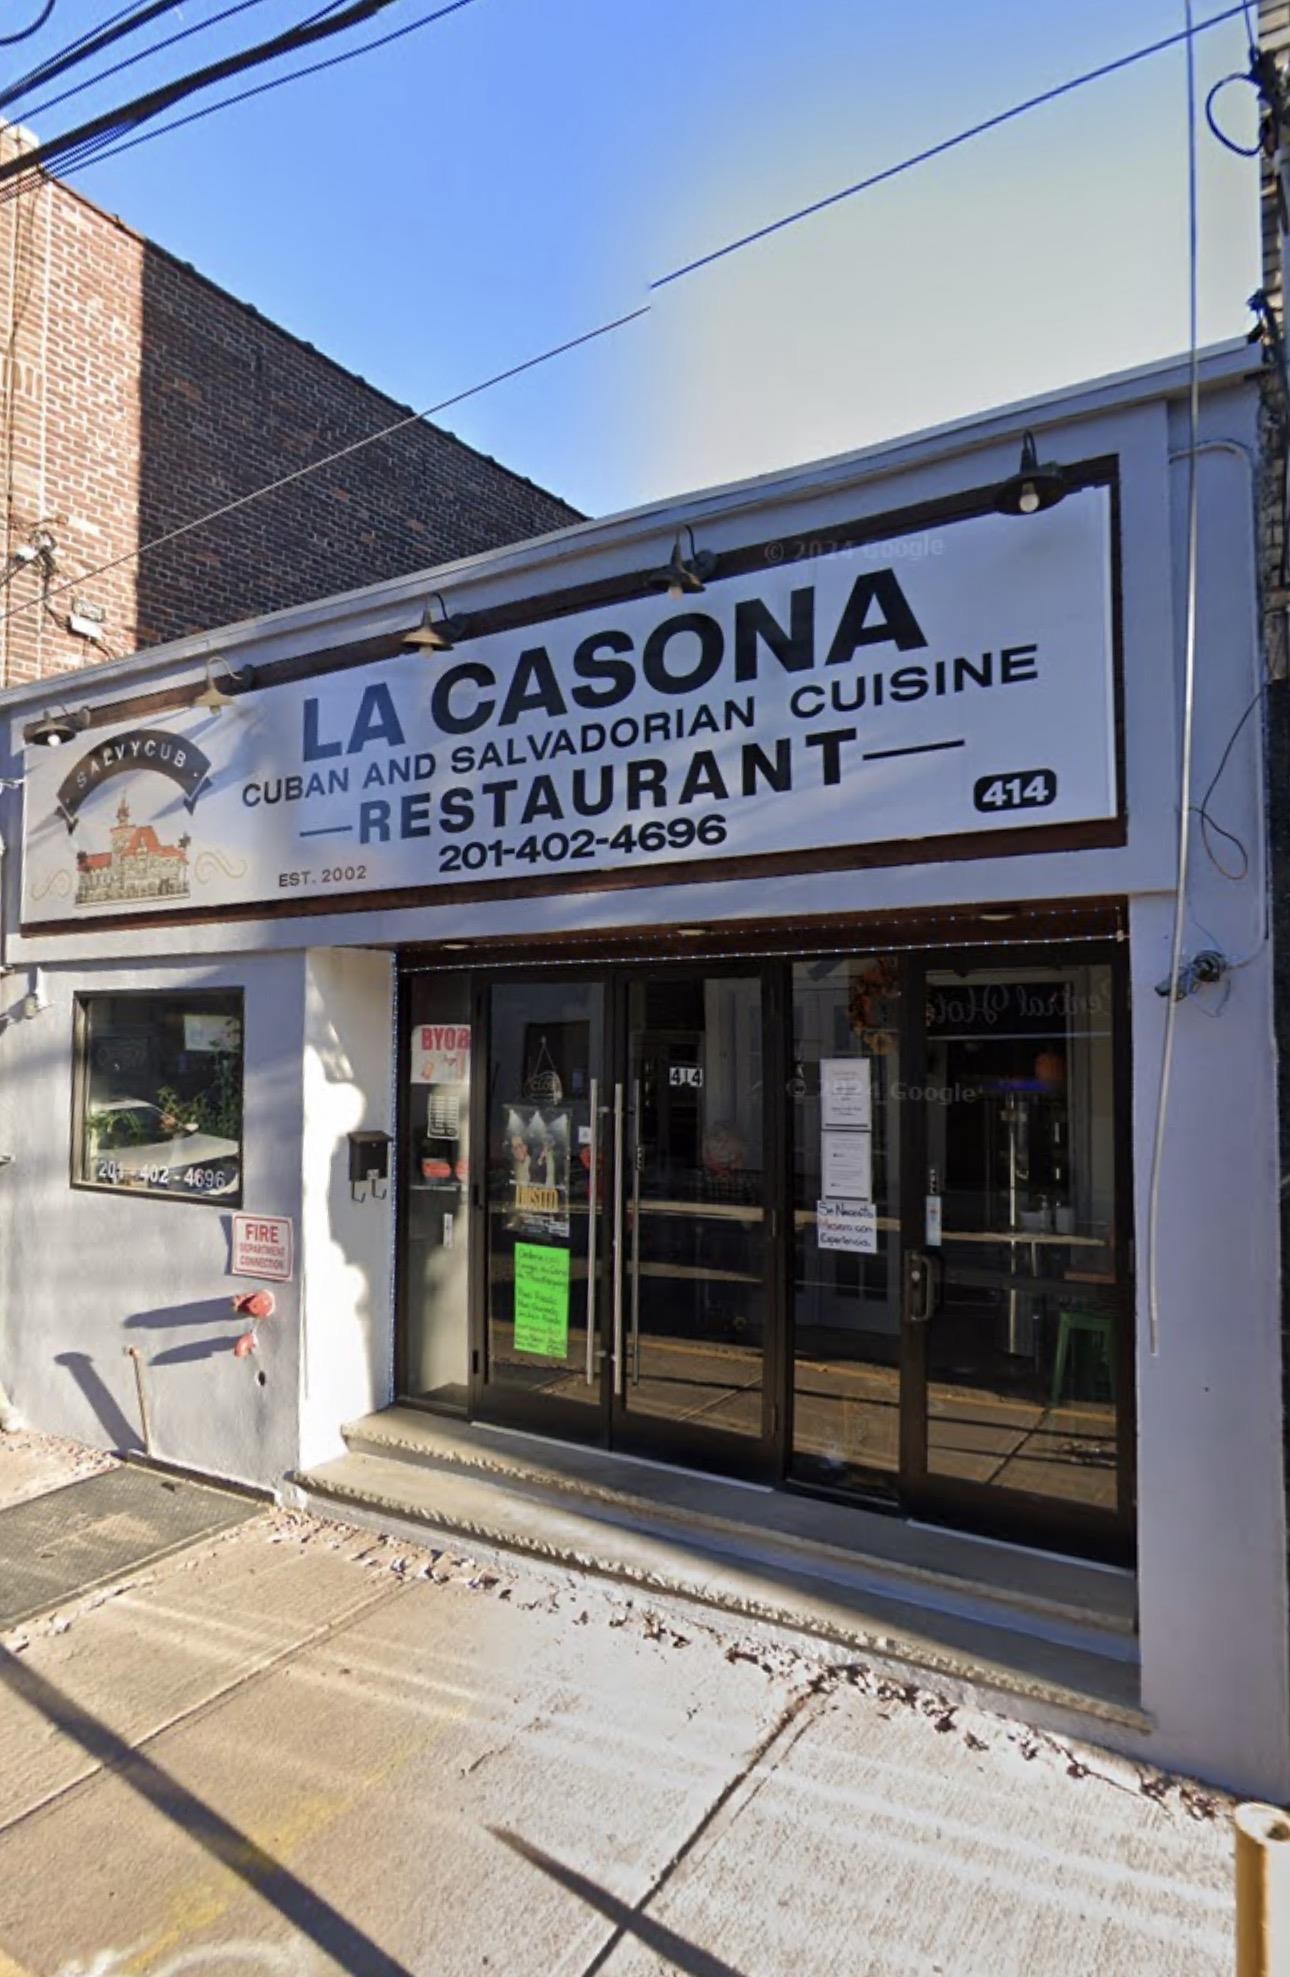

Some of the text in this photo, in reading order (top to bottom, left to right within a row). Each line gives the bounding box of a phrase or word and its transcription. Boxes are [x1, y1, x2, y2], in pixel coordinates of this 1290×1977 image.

[303, 569, 928, 762] LA CASONA
[243, 644, 1038, 807] CUBAN AND SALVADORIAN CUISINE
[360, 728, 857, 844] RESTAURANT
[982, 775, 1049, 806] 414
[439, 814, 727, 872] 201-402-4696
[279, 865, 367, 887] EST. 2002
[421, 1027, 470, 1051] BYOB
[671, 1068, 701, 1086] 414
[245, 1224, 279, 1243] FIRE
[240, 1242, 285, 1257] DEPARTMENT
[240, 1255, 284, 1271] CONNECTION
